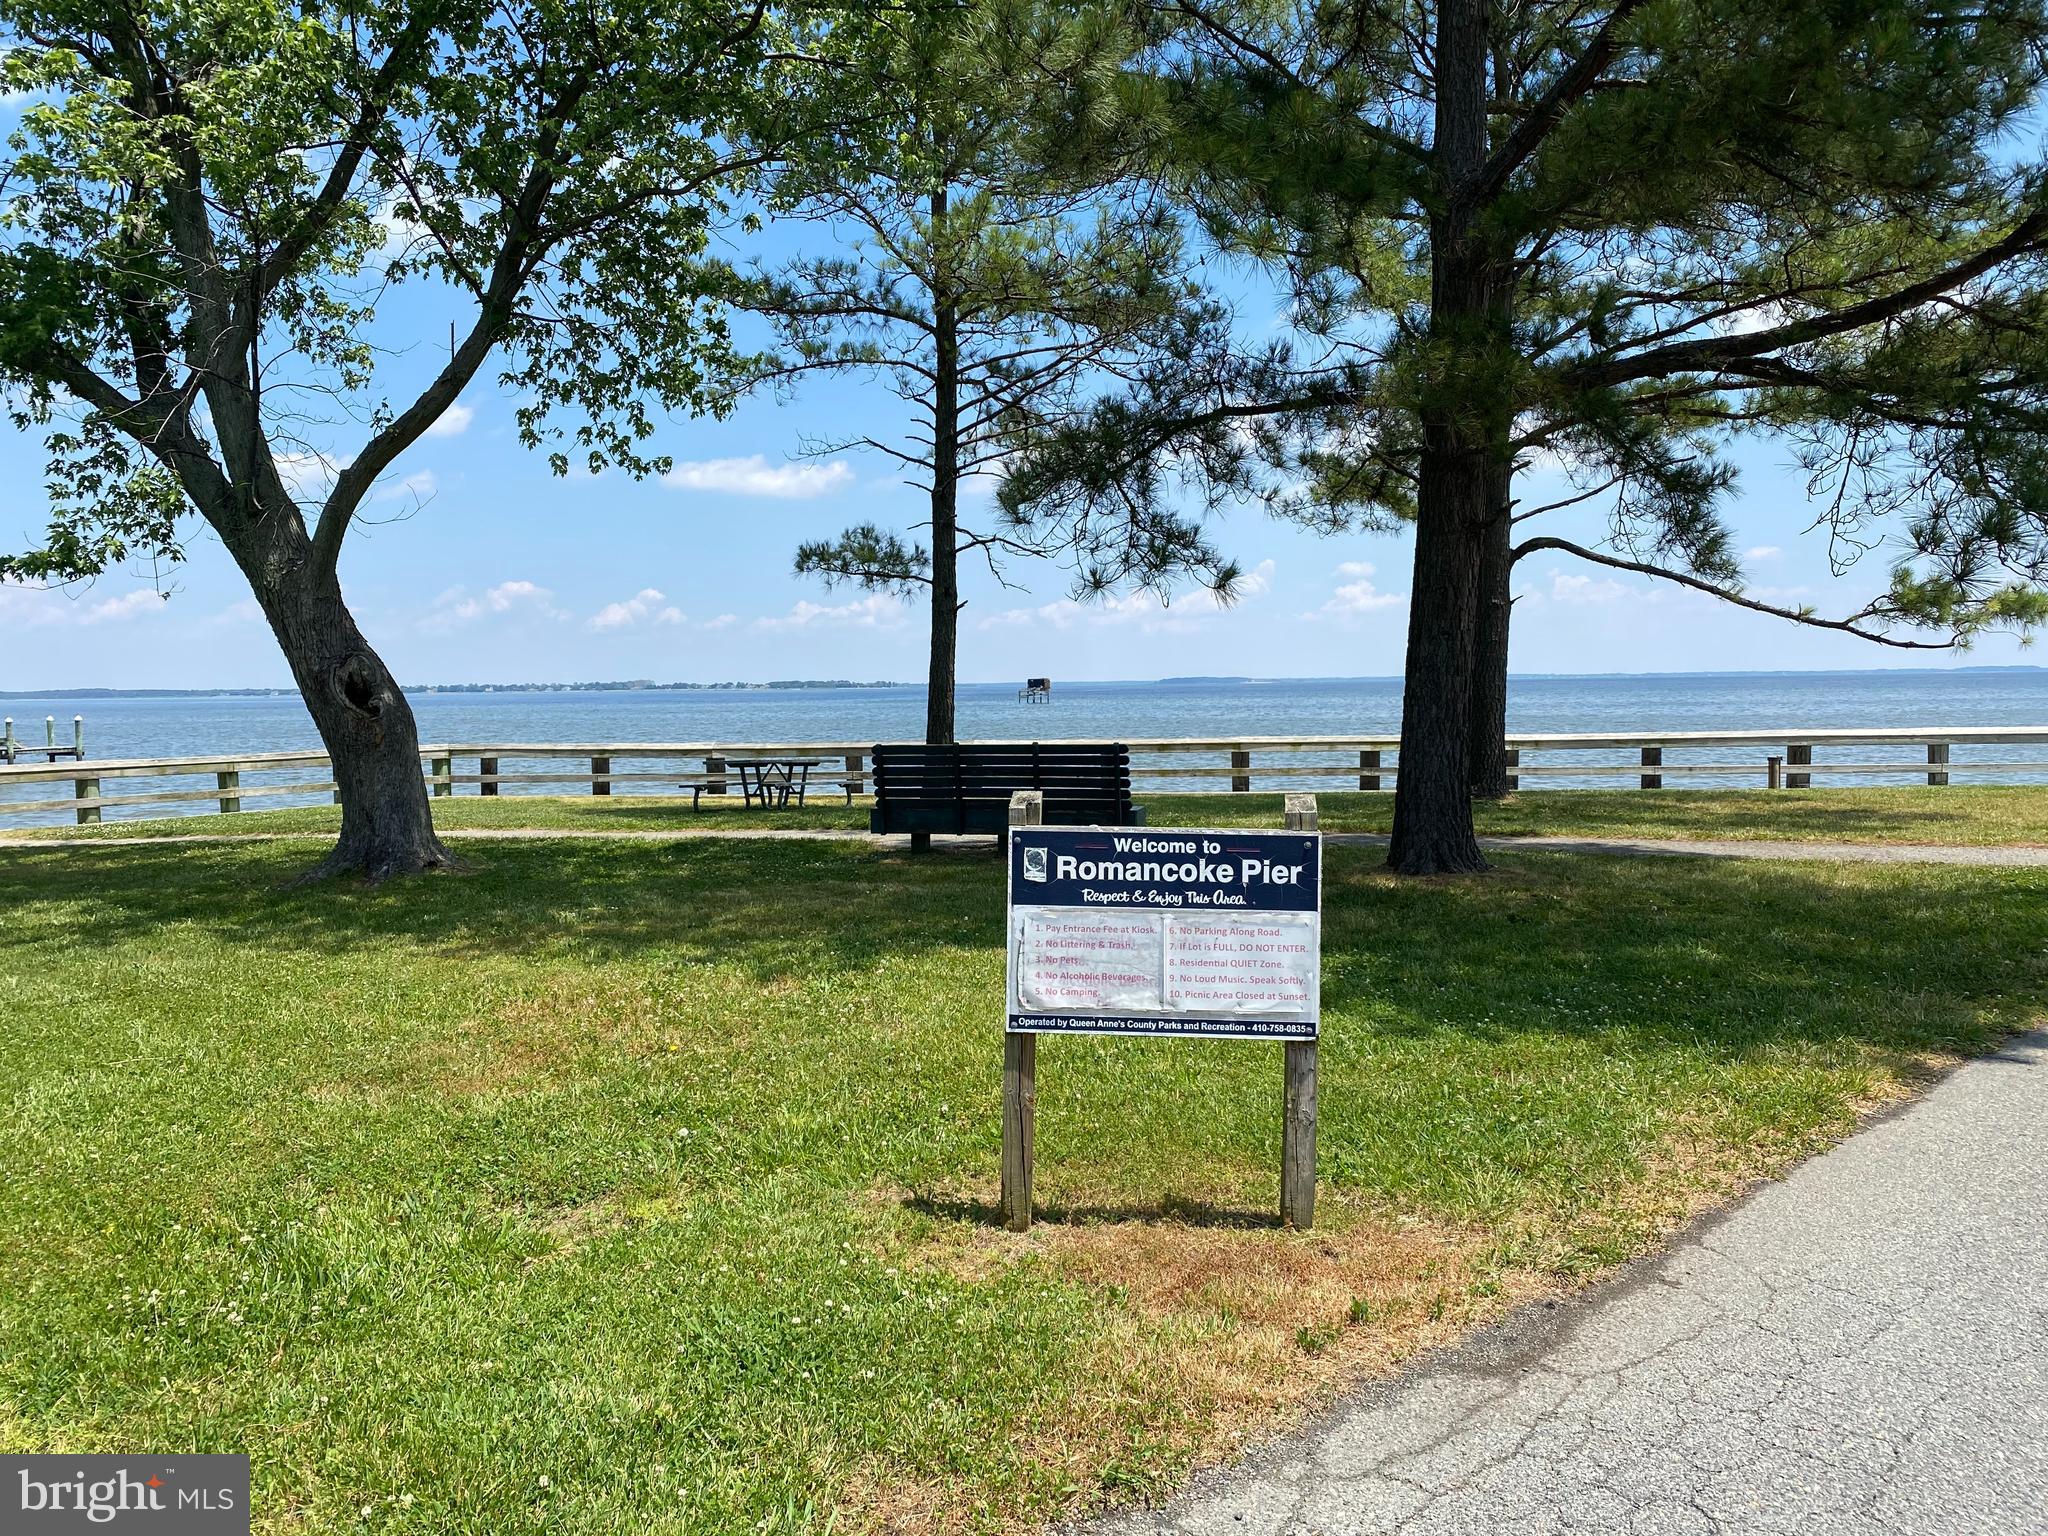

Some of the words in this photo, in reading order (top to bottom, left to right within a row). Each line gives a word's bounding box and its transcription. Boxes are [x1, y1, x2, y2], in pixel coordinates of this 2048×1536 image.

[1114, 838, 1196, 853] Welcome
[1202, 840, 1220, 854] to
[1057, 856, 1234, 883] Romancoke
[1242, 859, 1302, 884] Pier
[1082, 888, 1130, 904] Respect
[1132, 890, 1146, 902] &
[1148, 890, 1183, 906] Enjoy
[1185, 891, 1211, 903] This
[1213, 890, 1246, 905] Area.
[1046, 925, 1060, 933] Pay
[1195, 928, 1227, 937] Parking
[1230, 928, 1255, 937] Along
[1258, 928, 1282, 936] Road.
[1061, 941, 1096, 950] Littering
[1214, 944, 1237, 952] FULL,
[1180, 959, 1228, 967] Residential
[1230, 960, 1257, 968] QUIET
[1260, 960, 1284, 968] Zone.
[1219, 975, 1247, 984] Music.
[1250, 976, 1276, 985] Speak
[1279, 976, 1305, 986] Softly.
[1060, 988, 1100, 998] Camping.
[1185, 991, 1210, 999] Picnic
[1236, 991, 1264, 1000] Closed
[1278, 992, 1310, 1001] Sunset.
[1018, 1018, 1056, 1026] Operated
[1058, 1018, 1067, 1027] by
[1069, 1019, 1095, 1027] Queen
[1127, 1020, 1156, 1030] County
[1201, 1023, 1245, 1031] Recreation
[1252, 1024, 1306, 1032] 410-758-0835
